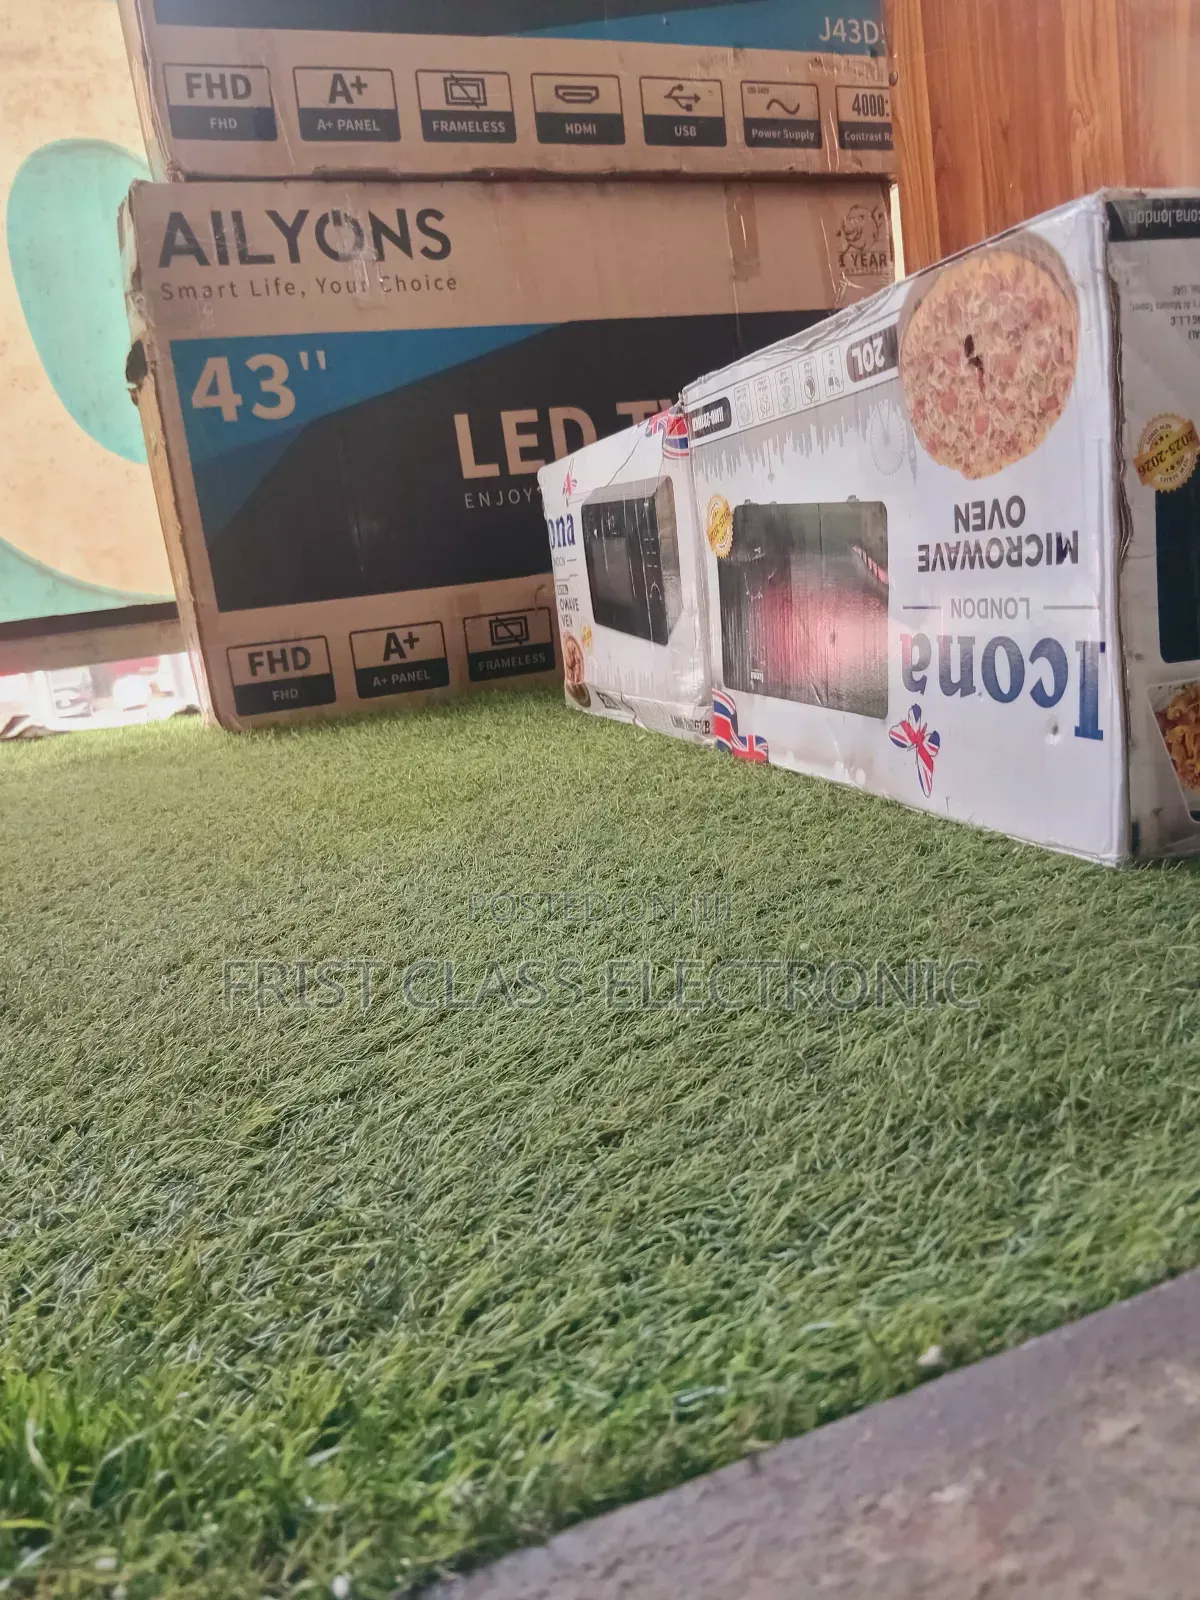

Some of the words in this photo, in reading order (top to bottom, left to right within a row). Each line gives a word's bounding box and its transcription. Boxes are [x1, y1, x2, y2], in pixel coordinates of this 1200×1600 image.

[184, 72, 252, 101] FHD
[327, 73, 368, 105] A+
[209, 117, 238, 130] FHD
[317, 119, 334, 131] A+
[337, 119, 380, 132] PANEL
[432, 120, 506, 134] FRAMELESS
[564, 122, 597, 136] HDMI
[674, 124, 697, 137] USB
[751, 128, 781, 139] Power
[783, 129, 815, 142] Supply
[844, 131, 882, 141] Contrast
[158, 207, 452, 268] AILYONS
[851, 252, 888, 269] YEAR
[160, 280, 239, 300] Smart
[250, 276, 306, 299] Life,
[315, 275, 367, 295] Your
[380, 273, 458, 294] Choice
[851, 336, 885, 376] 20L
[191, 350, 327, 423] 43"
[453, 406, 598, 480] LED
[616, 399, 679, 425] T
[1137, 428, 1197, 476] 2025-2026
[954, 495, 1026, 533] OVEN
[917, 530, 1079, 572] MICROWAVE
[950, 597, 1031, 620] LONDON
[383, 631, 420, 663] A+
[248, 645, 312, 678] FHD
[478, 652, 547, 673] FRAMELESS
[373, 674, 389, 687] A+
[390, 670, 431, 686] PANEL
[899, 632, 1106, 741] Icona
[272, 687, 299, 701] FHD
